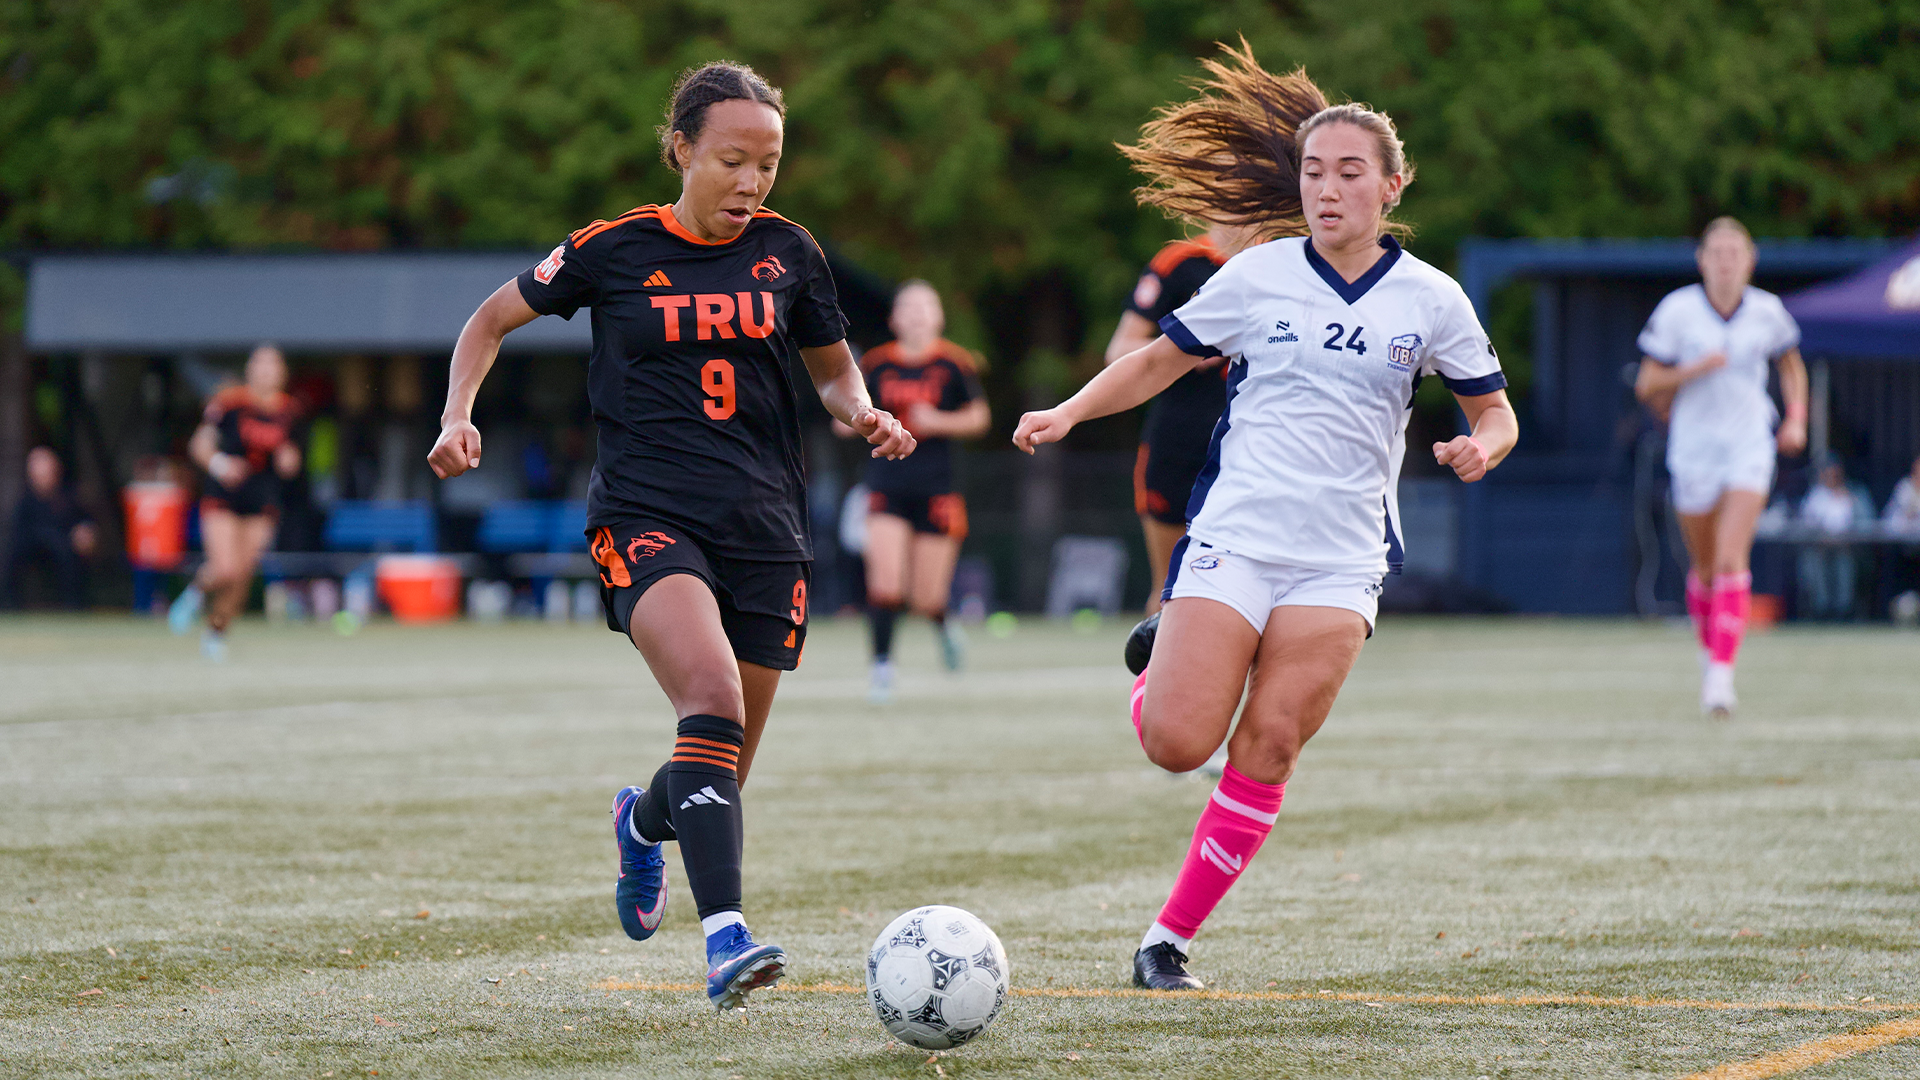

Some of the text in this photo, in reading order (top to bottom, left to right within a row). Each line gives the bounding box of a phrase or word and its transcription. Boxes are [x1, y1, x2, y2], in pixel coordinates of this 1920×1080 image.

[649, 291, 775, 341] TRU
[1267, 332, 1299, 344] oneills
[1323, 322, 1367, 356] 24
[700, 359, 736, 420] 9
[791, 579, 806, 626] 9
